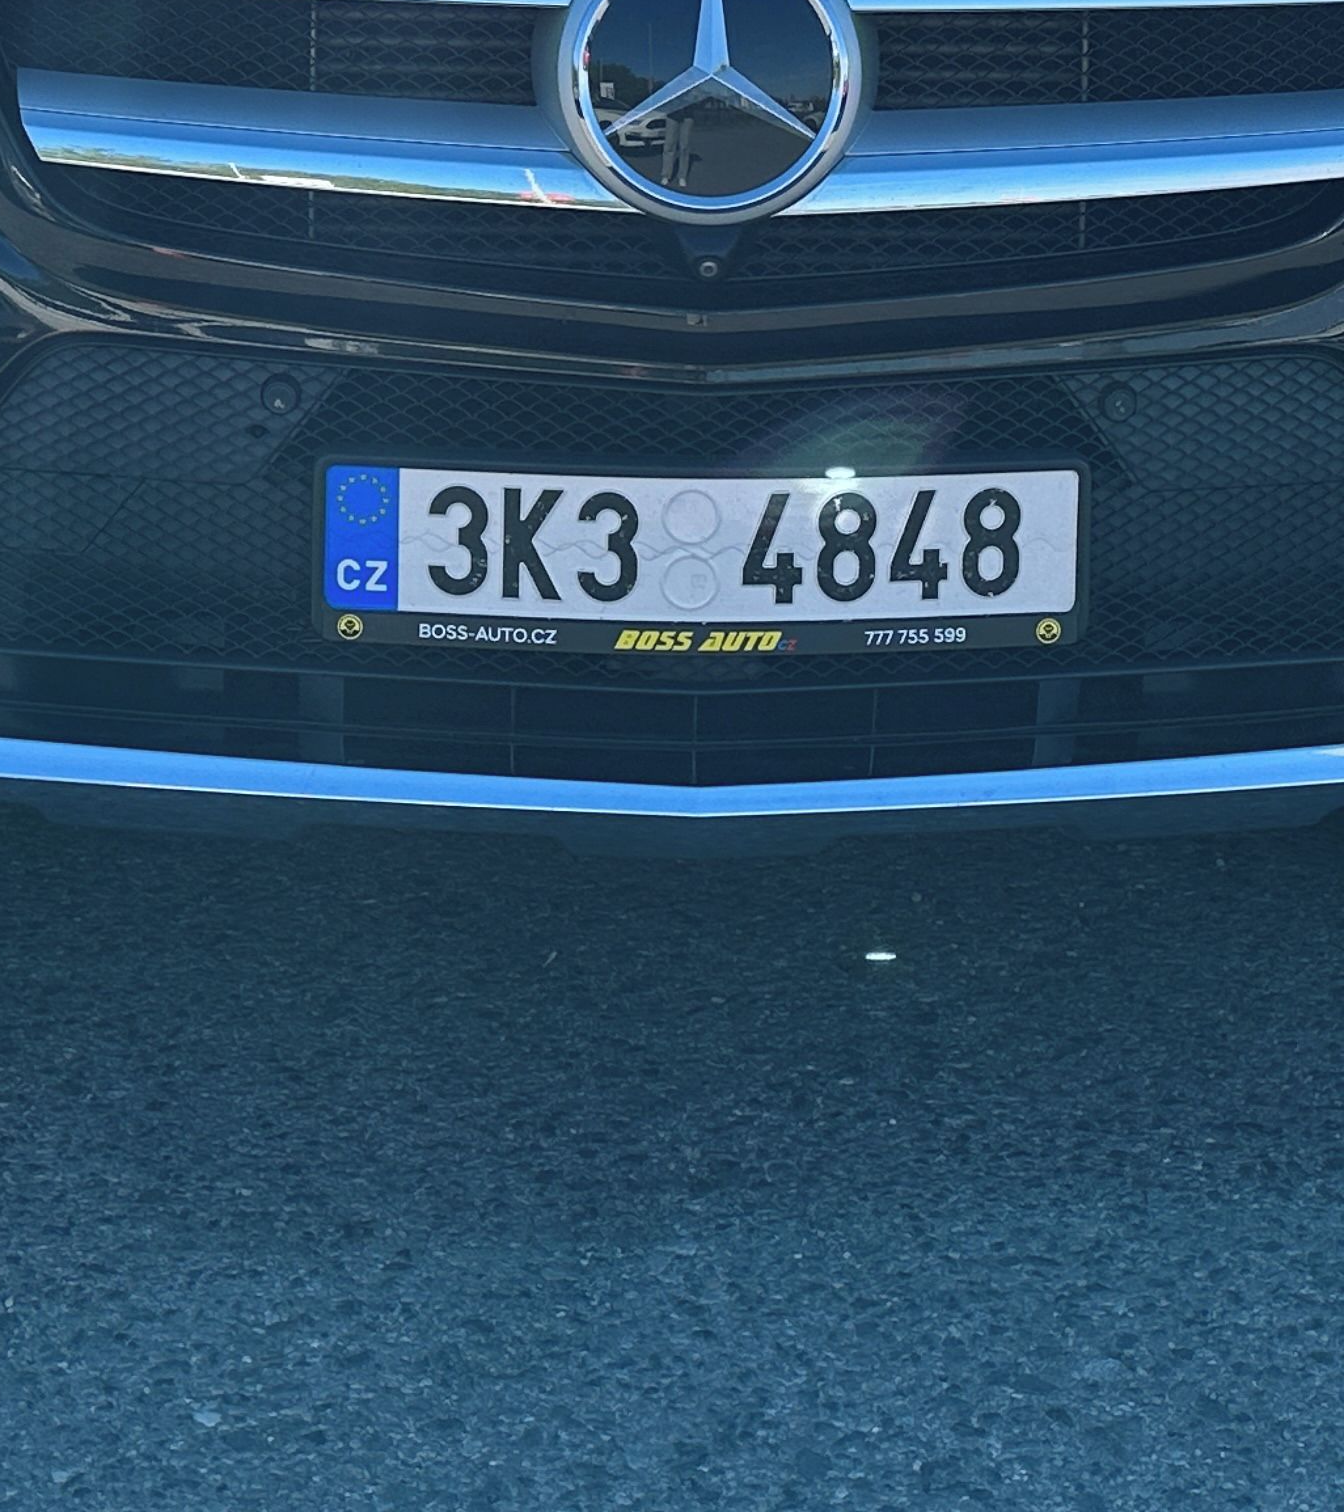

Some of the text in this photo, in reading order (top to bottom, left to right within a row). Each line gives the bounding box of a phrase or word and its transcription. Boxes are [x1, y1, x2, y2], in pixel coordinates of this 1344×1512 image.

[336, 485, 1021, 604] CZ 3K3 4848
[418, 623, 557, 645] BOSS-AUTO.CZ
[614, 629, 694, 651] BOSS
[697, 631, 782, 652] AUTO
[864, 627, 966, 646] 777 755 599
